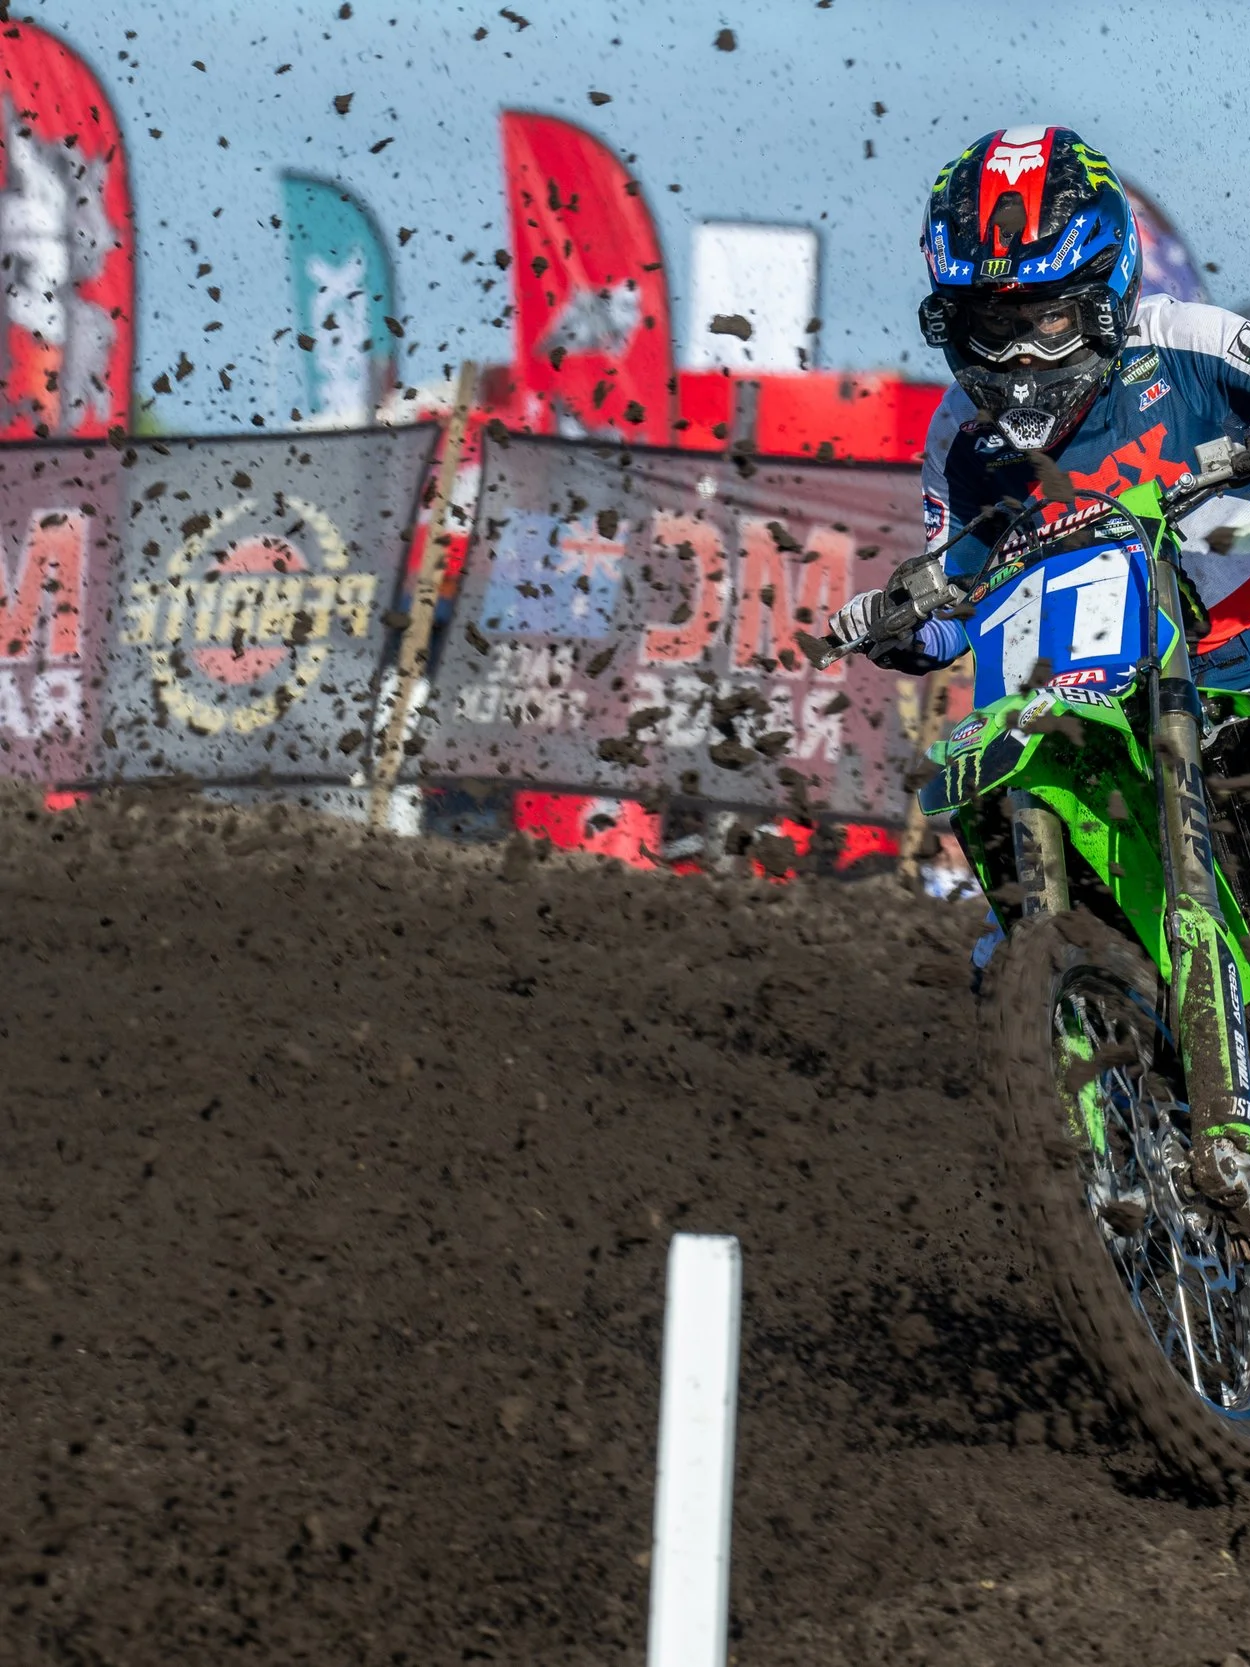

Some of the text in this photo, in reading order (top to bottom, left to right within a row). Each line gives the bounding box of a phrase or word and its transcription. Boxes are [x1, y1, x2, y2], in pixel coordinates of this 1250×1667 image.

[1051, 228, 1079, 271] apdesigns
[926, 309, 949, 344] FOX
[1122, 354, 1160, 386] MOTOCROS
[1139, 379, 1171, 408] AMA
[980, 549, 1130, 696] 11
[1047, 668, 1106, 688] SA
